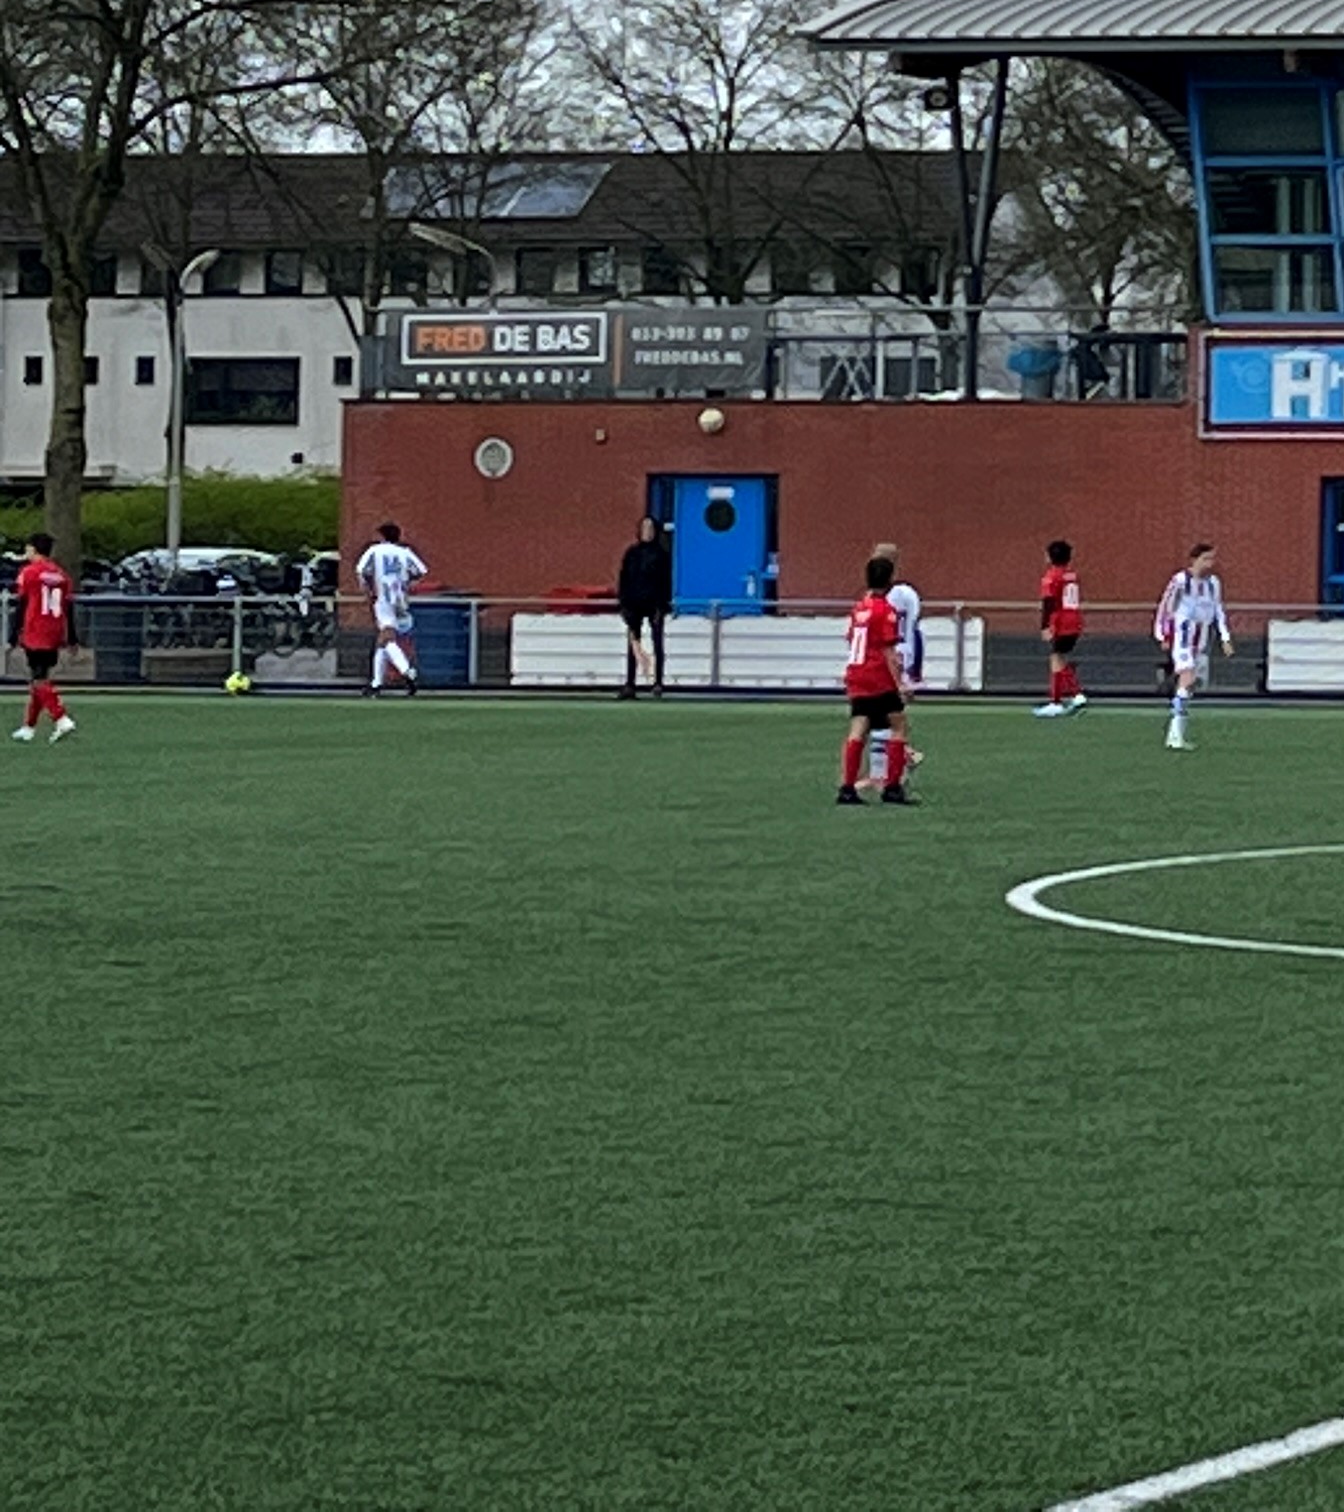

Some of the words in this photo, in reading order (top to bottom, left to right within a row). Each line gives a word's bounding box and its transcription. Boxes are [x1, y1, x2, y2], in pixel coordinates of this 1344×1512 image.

[416, 325, 486, 352] FRED
[493, 325, 530, 352] DE
[536, 324, 591, 351] BAS
[416, 369, 591, 385] MAKELAARDIJ
